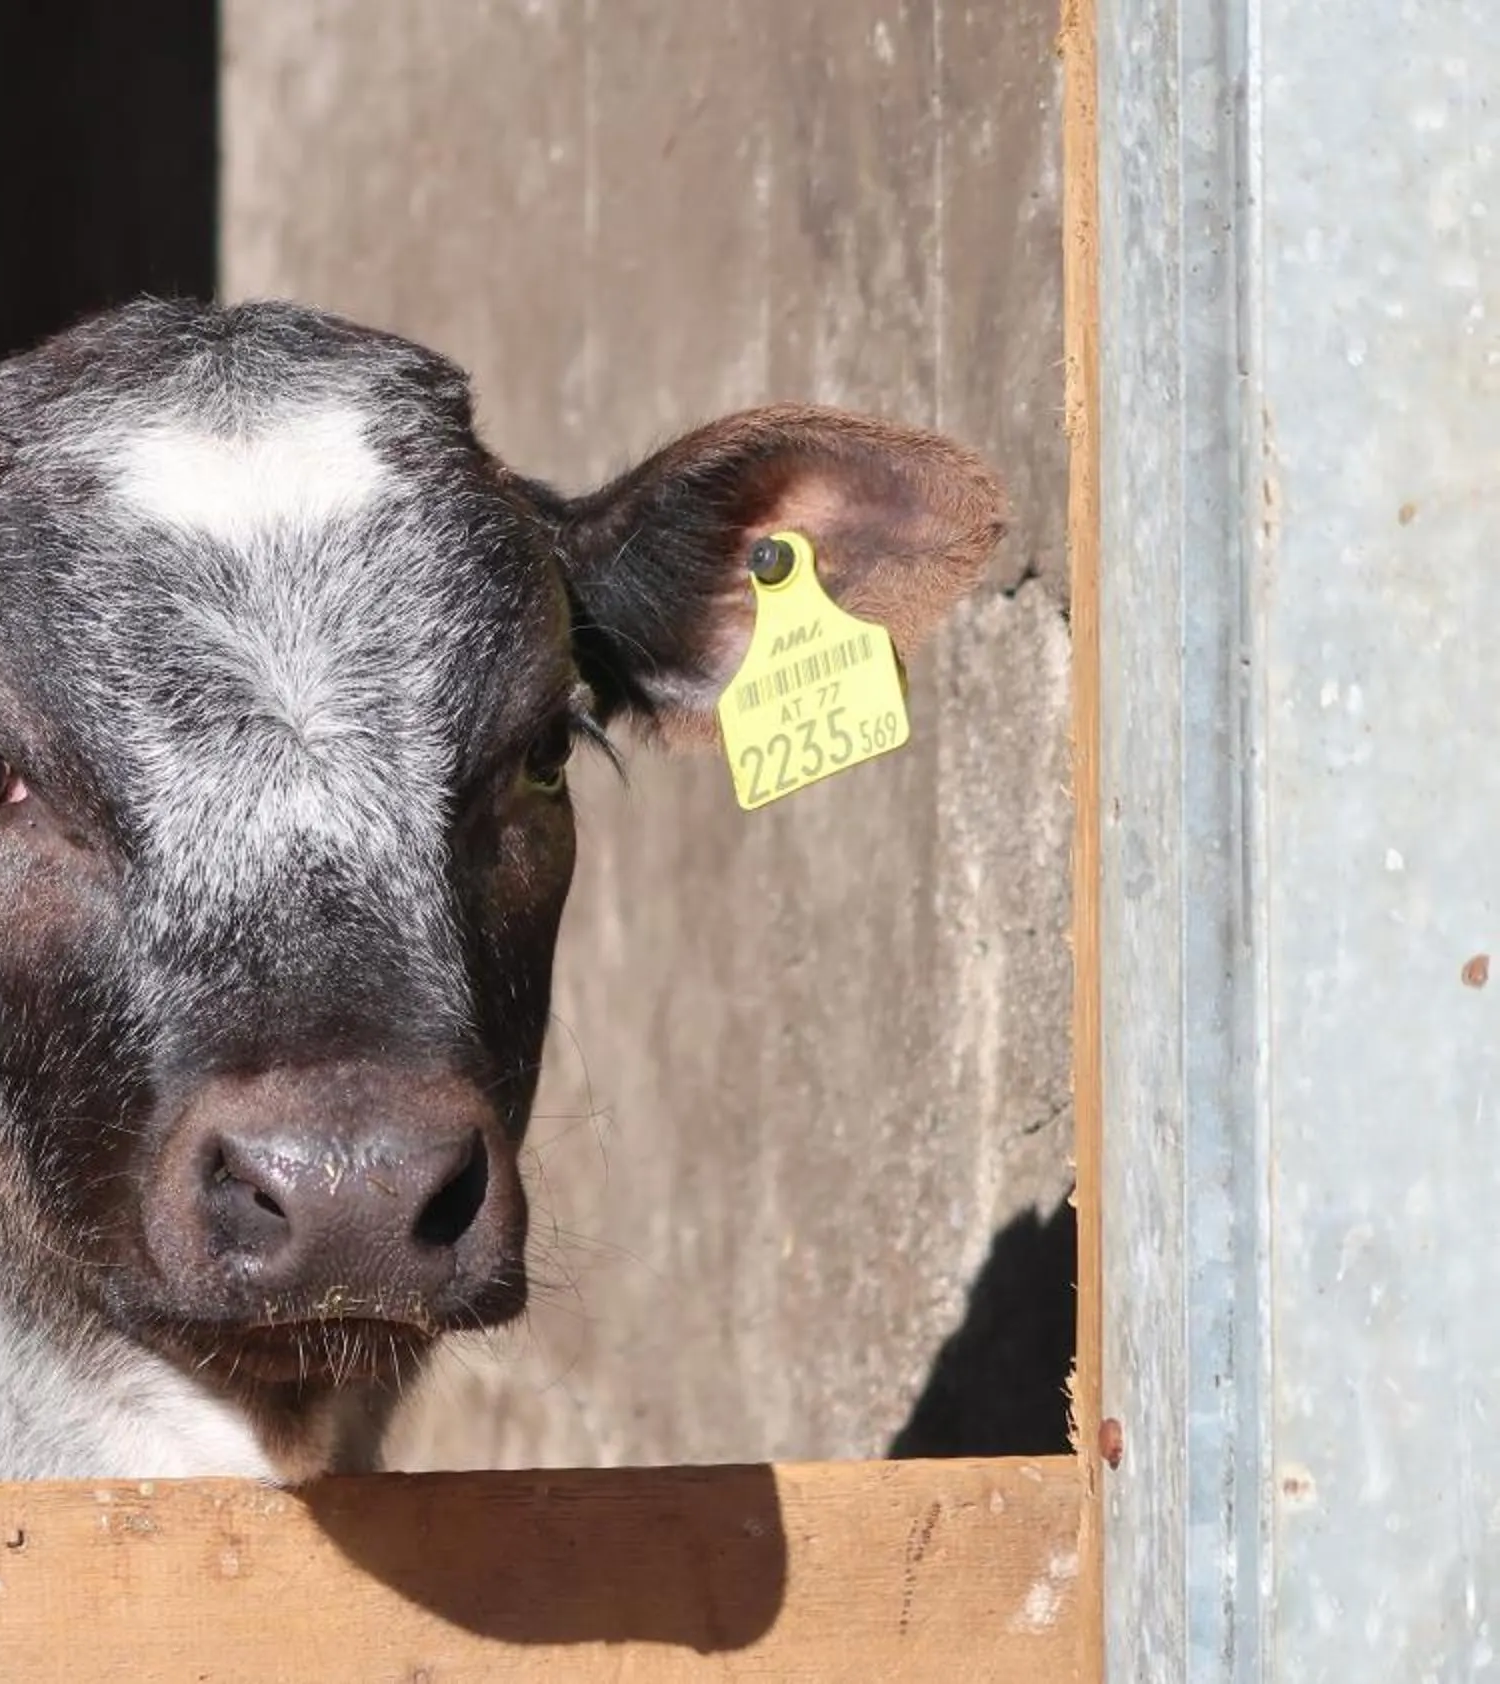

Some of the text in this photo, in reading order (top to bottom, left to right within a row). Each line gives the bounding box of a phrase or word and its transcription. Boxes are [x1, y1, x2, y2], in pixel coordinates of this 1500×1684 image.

[780, 682, 842, 726] AT 77
[739, 706, 898, 804] 2235 569
